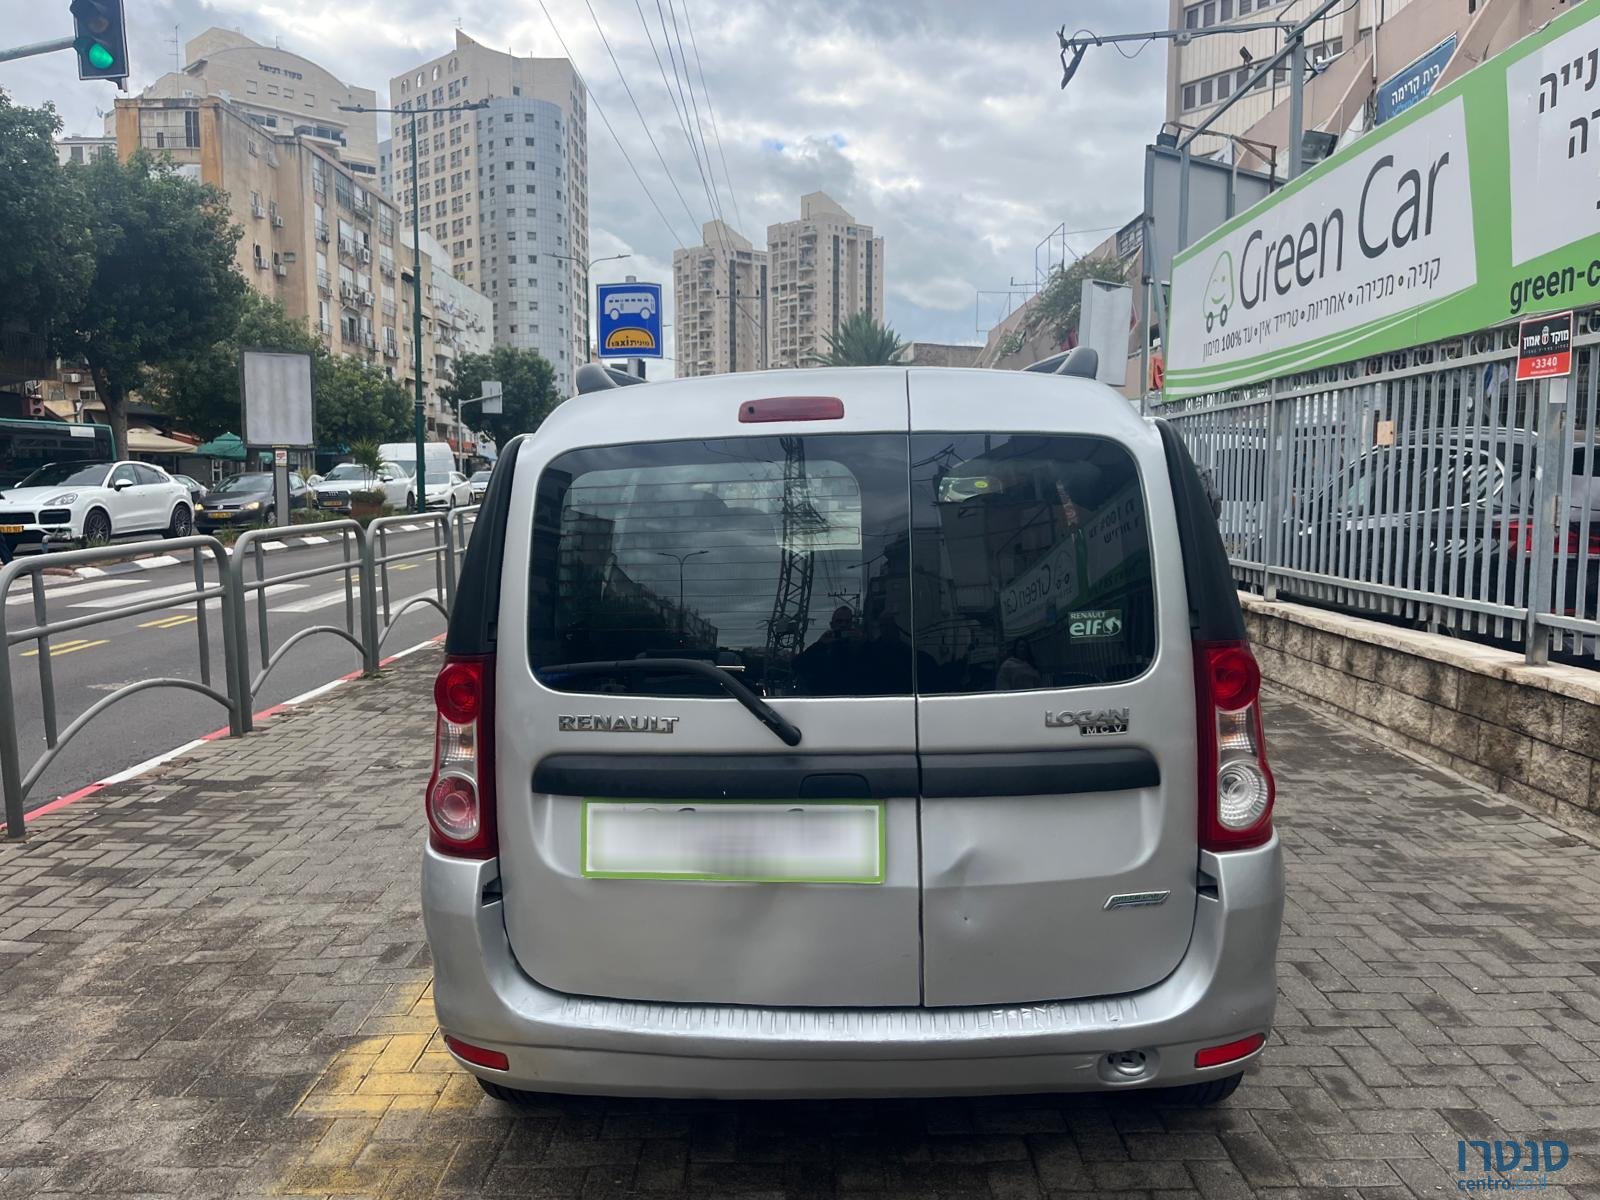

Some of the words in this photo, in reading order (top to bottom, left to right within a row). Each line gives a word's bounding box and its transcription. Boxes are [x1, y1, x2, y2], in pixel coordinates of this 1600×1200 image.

[1391, 75, 1420, 106] קדימה
[1239, 208, 1344, 310] Green
[1357, 152, 1450, 259] Car
[1406, 257, 1441, 290] קניה
[1355, 273, 1395, 306] מכירה
[1306, 291, 1346, 322] אחריות
[611, 335, 629, 347] taxi
[1221, 329, 1242, 352] 100%
[1550, 329, 1570, 346] מוקד
[1069, 610, 1106, 620] RENAULT
[1069, 619, 1103, 636] elf
[558, 714, 680, 734] RENAULT
[1044, 706, 1130, 728] LOGAN
[1085, 724, 1123, 736] MCV
